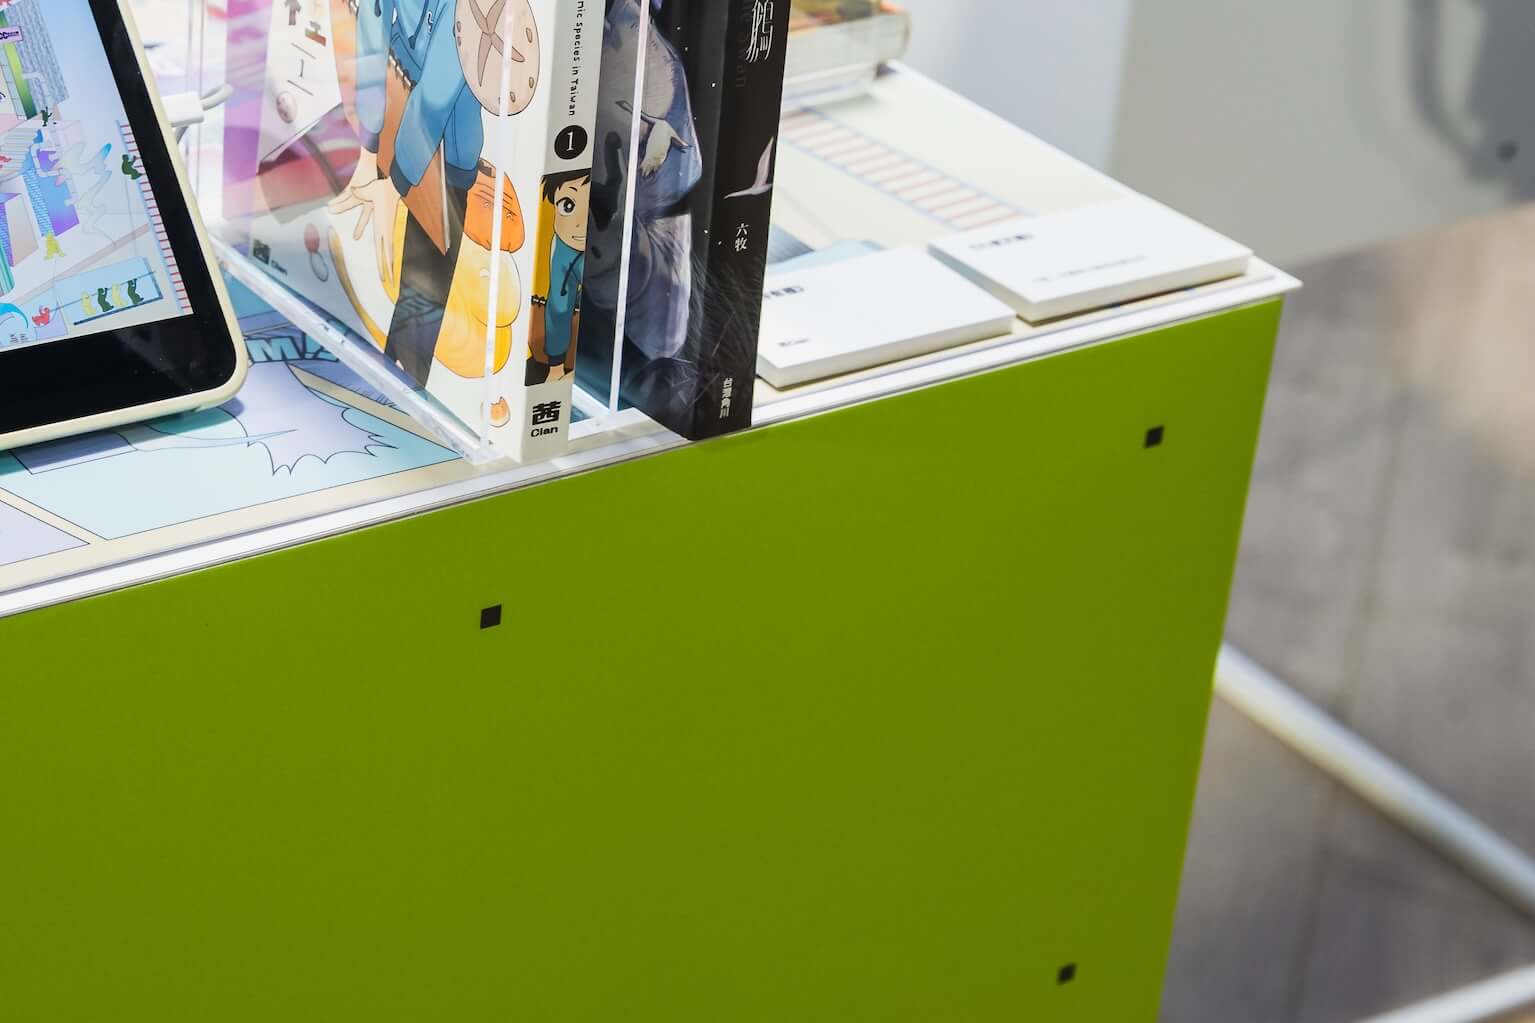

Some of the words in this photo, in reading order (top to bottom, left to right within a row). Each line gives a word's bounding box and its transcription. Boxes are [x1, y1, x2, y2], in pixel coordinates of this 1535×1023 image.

[573, 22, 583, 62] Species
[572, 65, 582, 76] in
[568, 78, 580, 116] Taiwan
[734, 222, 750, 252] 六牧
[531, 400, 562, 426] 茜
[530, 426, 559, 438] Cian
